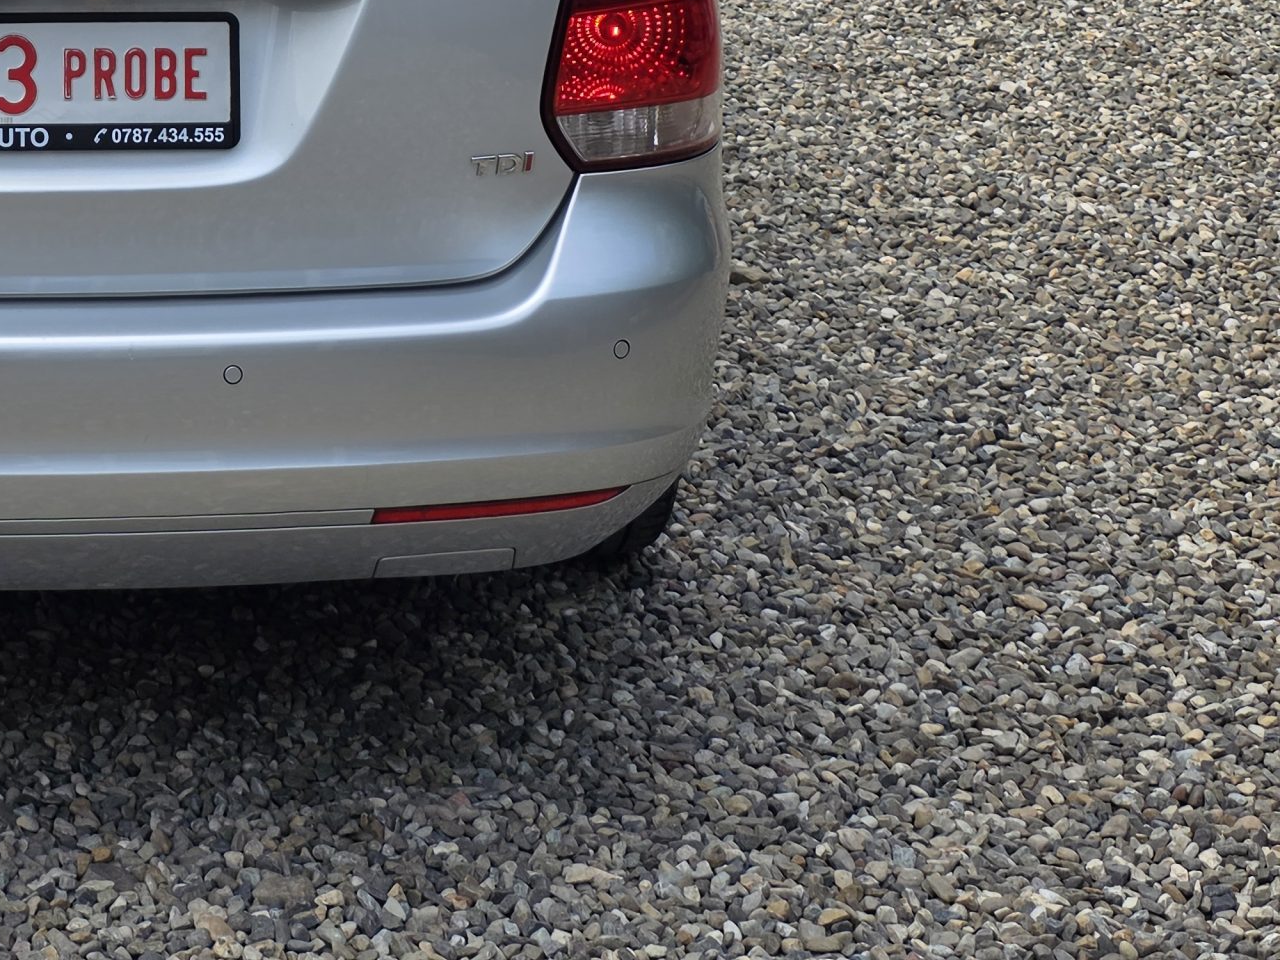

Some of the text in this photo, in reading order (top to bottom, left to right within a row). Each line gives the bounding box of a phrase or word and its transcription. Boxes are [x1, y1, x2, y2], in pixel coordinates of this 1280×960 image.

[63, 47, 208, 101] PROBE
[111, 127, 225, 144] 0787.434.555
[471, 151, 535, 176] TDI
